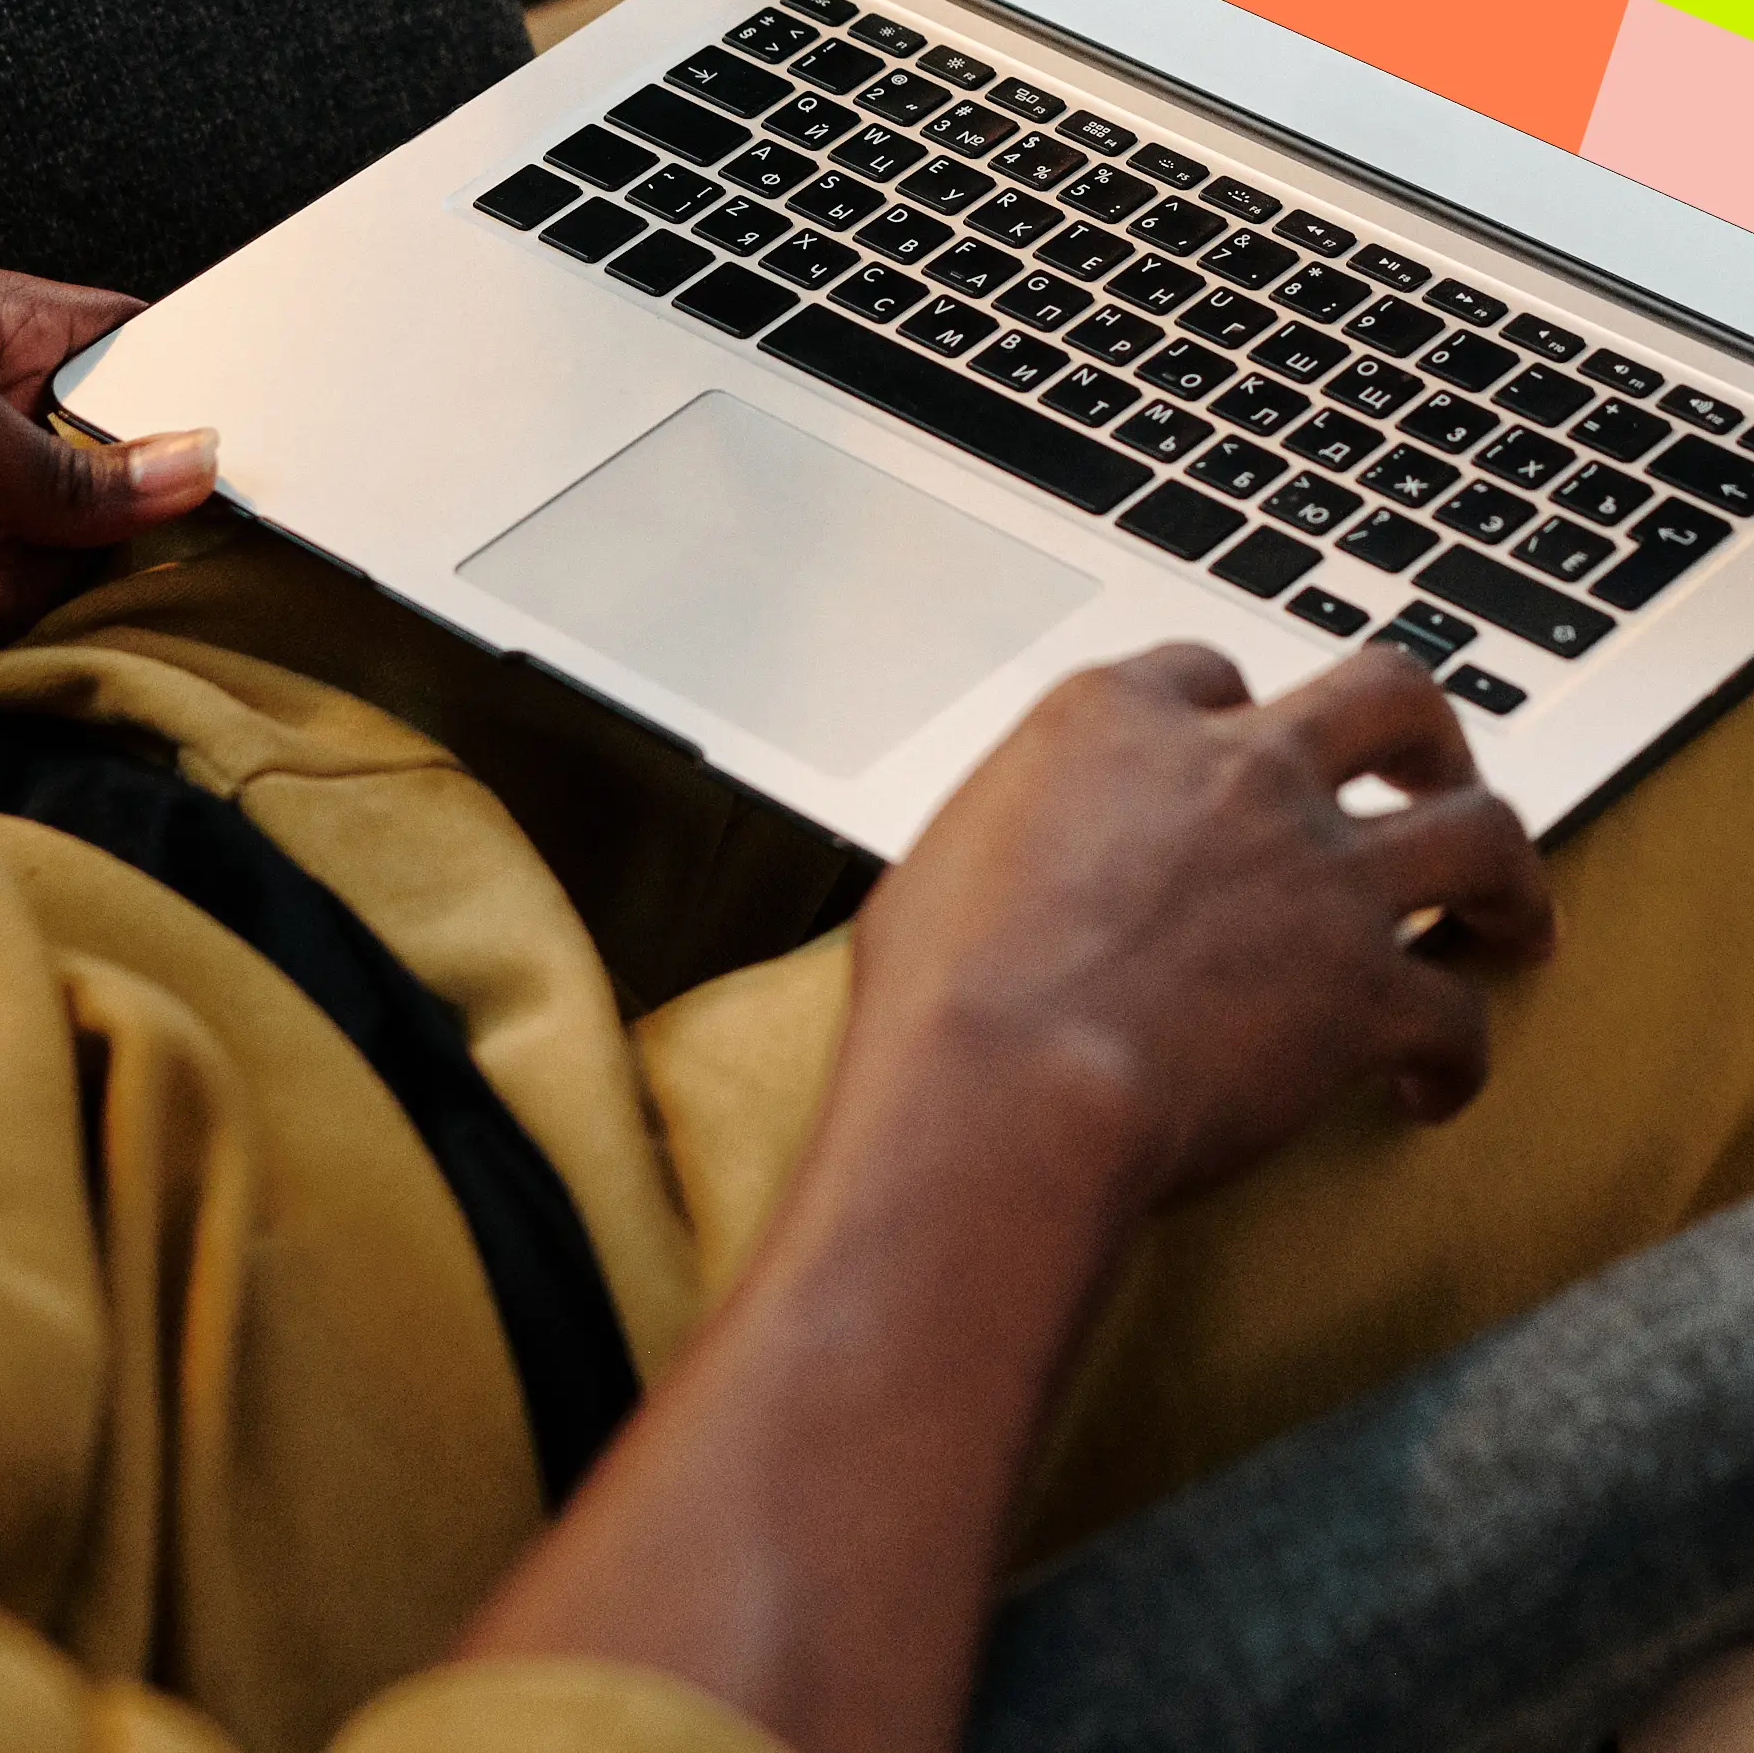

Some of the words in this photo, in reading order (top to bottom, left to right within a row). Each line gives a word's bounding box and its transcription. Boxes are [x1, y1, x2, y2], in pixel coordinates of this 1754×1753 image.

[801, 55, 817, 68] 1
[962, 71, 977, 82] F2
[865, 87, 885, 101] 2
[797, 97, 818, 114] Q
[1032, 105, 1046, 115] F3
[803, 123, 830, 140] Й
[933, 119, 952, 132] 3
[863, 127, 891, 145] W
[1103, 138, 1118, 148] F4
[750, 146, 772, 161] A
[1003, 153, 1022, 164] 4
[869, 155, 895, 174] Ц
[928, 159, 950, 174] E
[761, 173, 781, 186] Ф
[819, 175, 841, 189] S
[1176, 172, 1191, 181] F5
[1070, 183, 1091, 196] 5
[996, 192, 1018, 208] R
[725, 200, 750, 217] Z
[827, 203, 854, 220] Ы
[886, 208, 909, 223] D
[1248, 205, 1263, 215] F6
[1141, 217, 1159, 229] 6
[736, 231, 760, 246] Я
[1069, 224, 1090, 239] T
[792, 233, 818, 250] X
[954, 241, 977, 254] F
[1322, 238, 1337, 248] F7
[1211, 247, 1233, 260] 7
[810, 263, 828, 279] Ч
[1141, 257, 1162, 273] Y
[863, 267, 885, 283] C
[1397, 273, 1412, 283] F8
[1027, 276, 1050, 291] G
[1284, 282, 1303, 296] 8
[1210, 290, 1234, 308] U
[933, 299, 956, 315] V
[1035, 304, 1063, 322] П
[1473, 308, 1488, 318] F9
[1095, 308, 1122, 327] H
[1357, 315, 1376, 328] 9
[1221, 322, 1246, 335] Г
[1280, 324, 1296, 338] I
[999, 333, 1022, 350] B
[1168, 344, 1189, 357] J
[1431, 350, 1450, 364] 0
[1285, 352, 1319, 373] Ш
[1356, 360, 1379, 377] O
[1011, 364, 1038, 382] И
[1071, 367, 1099, 387] N
[1239, 376, 1265, 395] K
[1357, 386, 1392, 410] Щ
[1428, 393, 1452, 408] P
[1144, 403, 1174, 425] M
[1250, 407, 1279, 426] Л
[1313, 410, 1330, 429] L
[1158, 435, 1177, 453] Ь
[1317, 441, 1351, 464] Д
[1232, 471, 1255, 488] Б
[1393, 474, 1429, 498] Ж
[1297, 502, 1330, 525] Ю
[1479, 515, 1505, 533] Э
